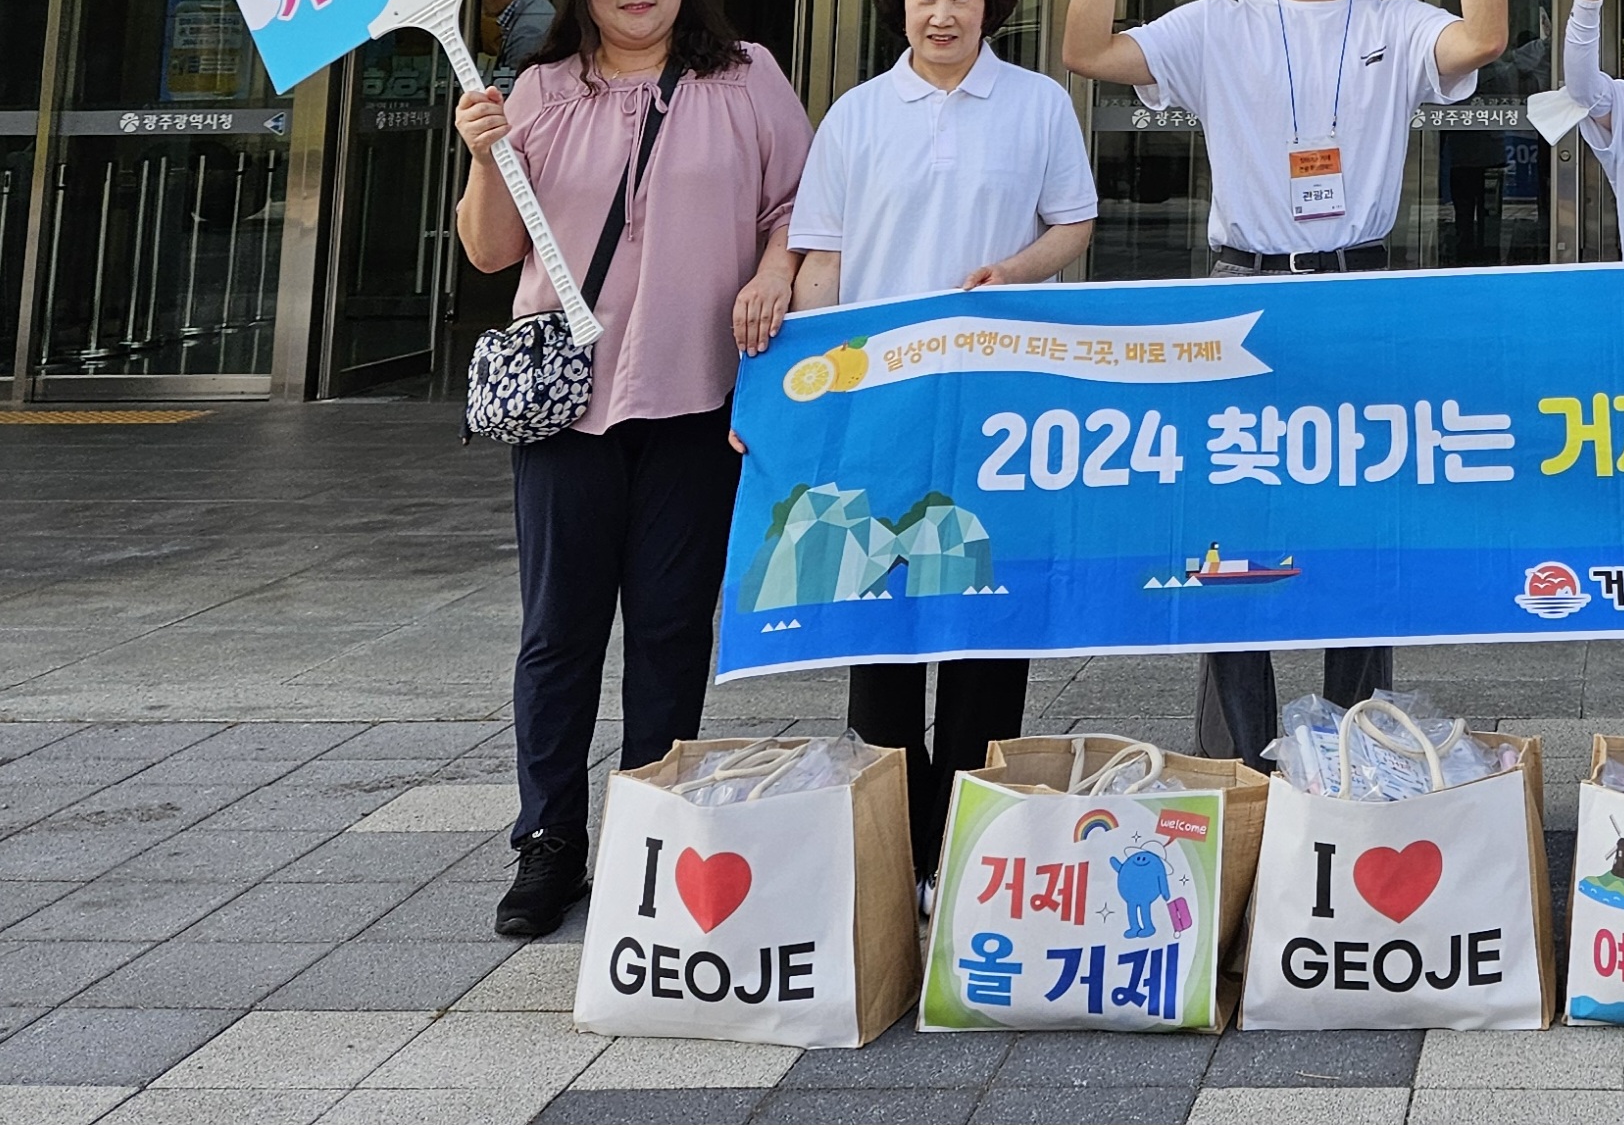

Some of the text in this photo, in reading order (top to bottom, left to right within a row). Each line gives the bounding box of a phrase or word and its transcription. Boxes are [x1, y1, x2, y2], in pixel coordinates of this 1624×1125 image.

[143, 114, 233, 131] 광주광역시청
[1155, 111, 1199, 127] 광주광
[1430, 110, 1519, 126] 광주광역시청
[1303, 189, 1334, 202] 관광과
[883, 331, 1222, 373] 일상이 여행이 되는 그곳, 바로 거제!
[977, 409, 1184, 492] 2024
[1206, 399, 1515, 486] 찾아가는
[1159, 817, 1207, 835] welcome
[638, 837, 663, 918] I
[977, 855, 1088, 926] 거제
[1311, 841, 1336, 918] I
[610, 937, 815, 1004] GEOJE
[958, 931, 1180, 1020] 올 거제
[1280, 928, 1502, 992] GEOJE
